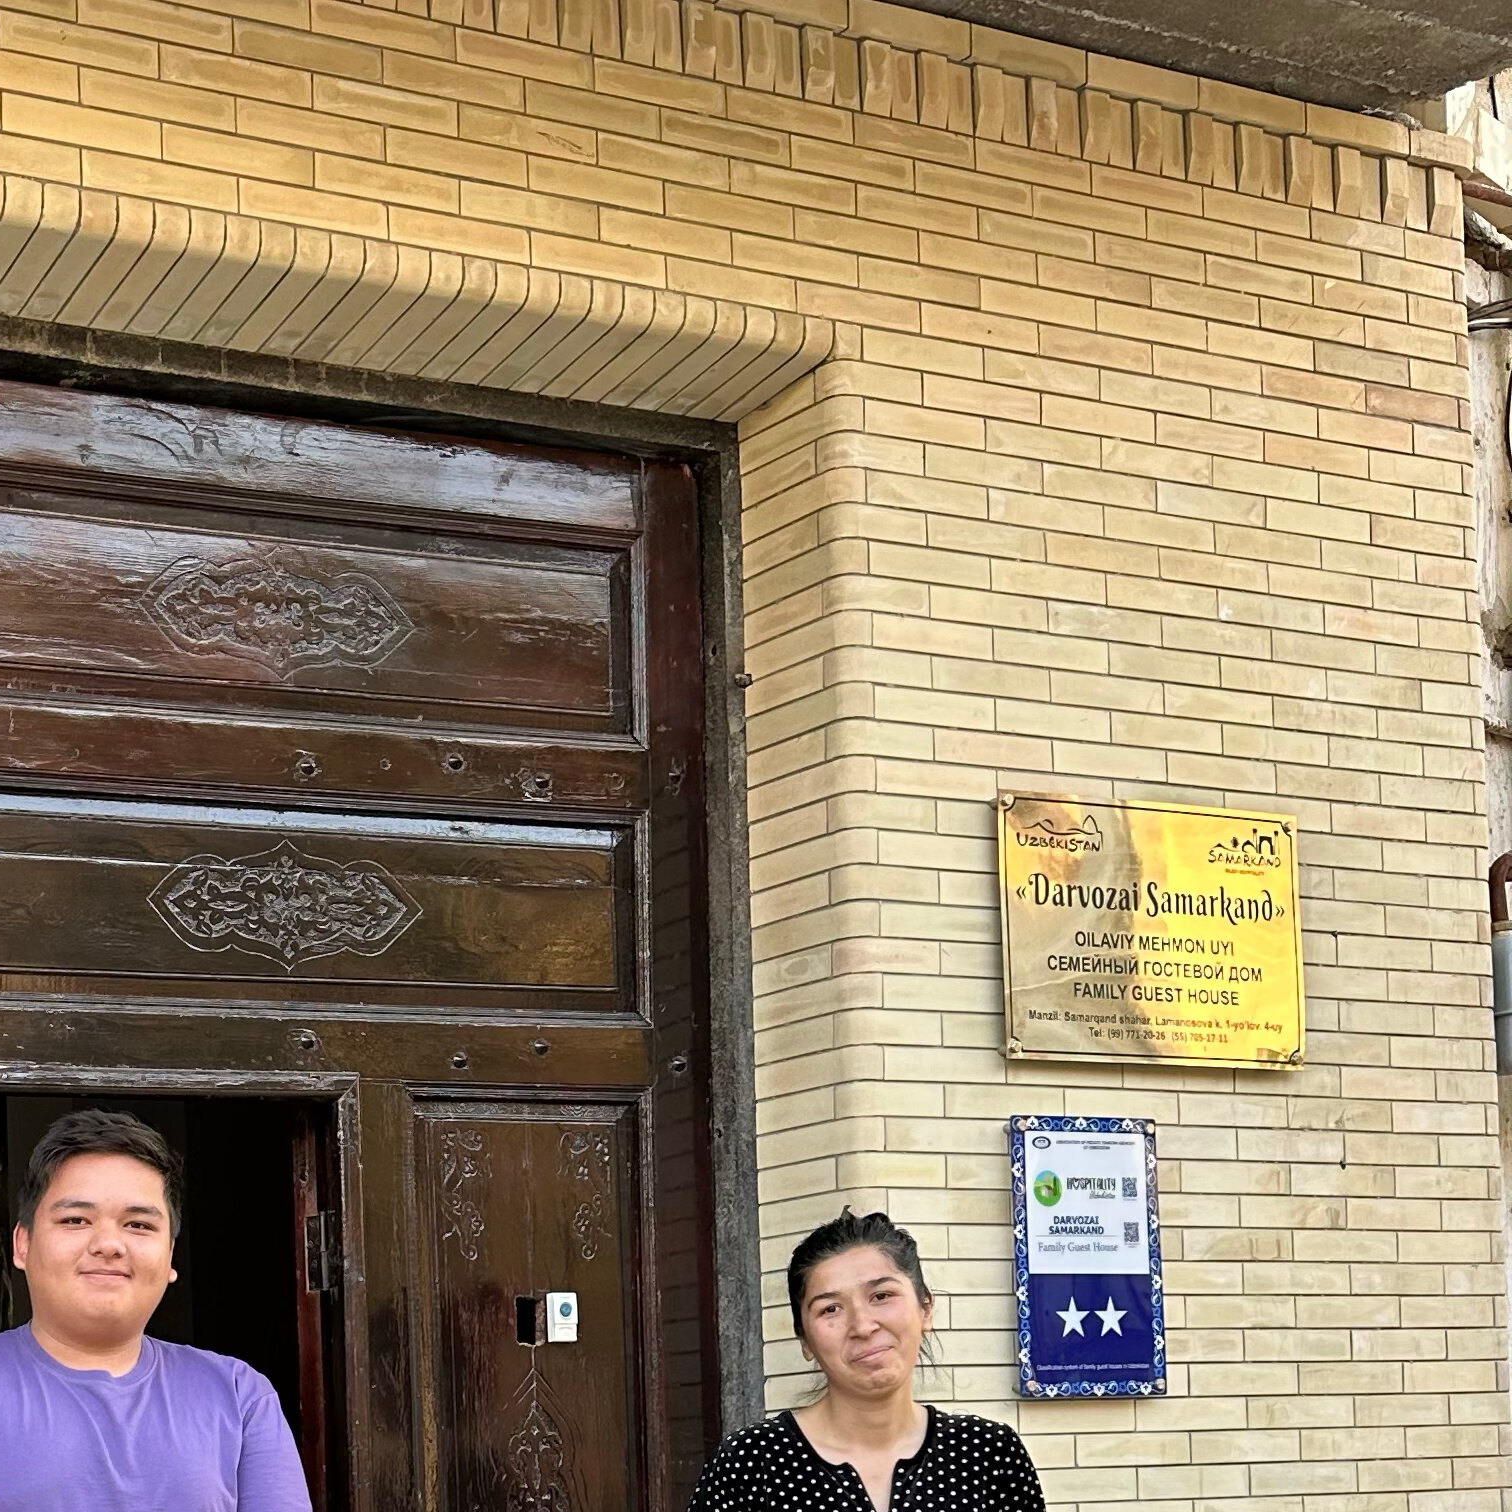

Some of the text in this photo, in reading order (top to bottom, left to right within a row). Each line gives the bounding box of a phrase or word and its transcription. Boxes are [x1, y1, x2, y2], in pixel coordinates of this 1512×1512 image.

[1016, 832, 1101, 852] UZBEKISTAN
[1208, 849, 1281, 868] SAMARKAND
[1016, 872, 1285, 926] «Darvozai Samarkand»
[1074, 931, 1234, 956] OILAVIY MEHMON UYI
[1047, 954, 1263, 983] СЕМЕЙНЫЙ ГОСТЕВОЙ ДОМ
[1073, 982, 1240, 1006] FAMILY GUEST HOUSE
[1048, 1225, 1105, 1235] SAMARKAND
[1053, 1215, 1100, 1225] DARVOZAI
[1037, 1241, 1066, 1255] Family
[1067, 1241, 1091, 1252] Guest
[1093, 1241, 1119, 1252] House
